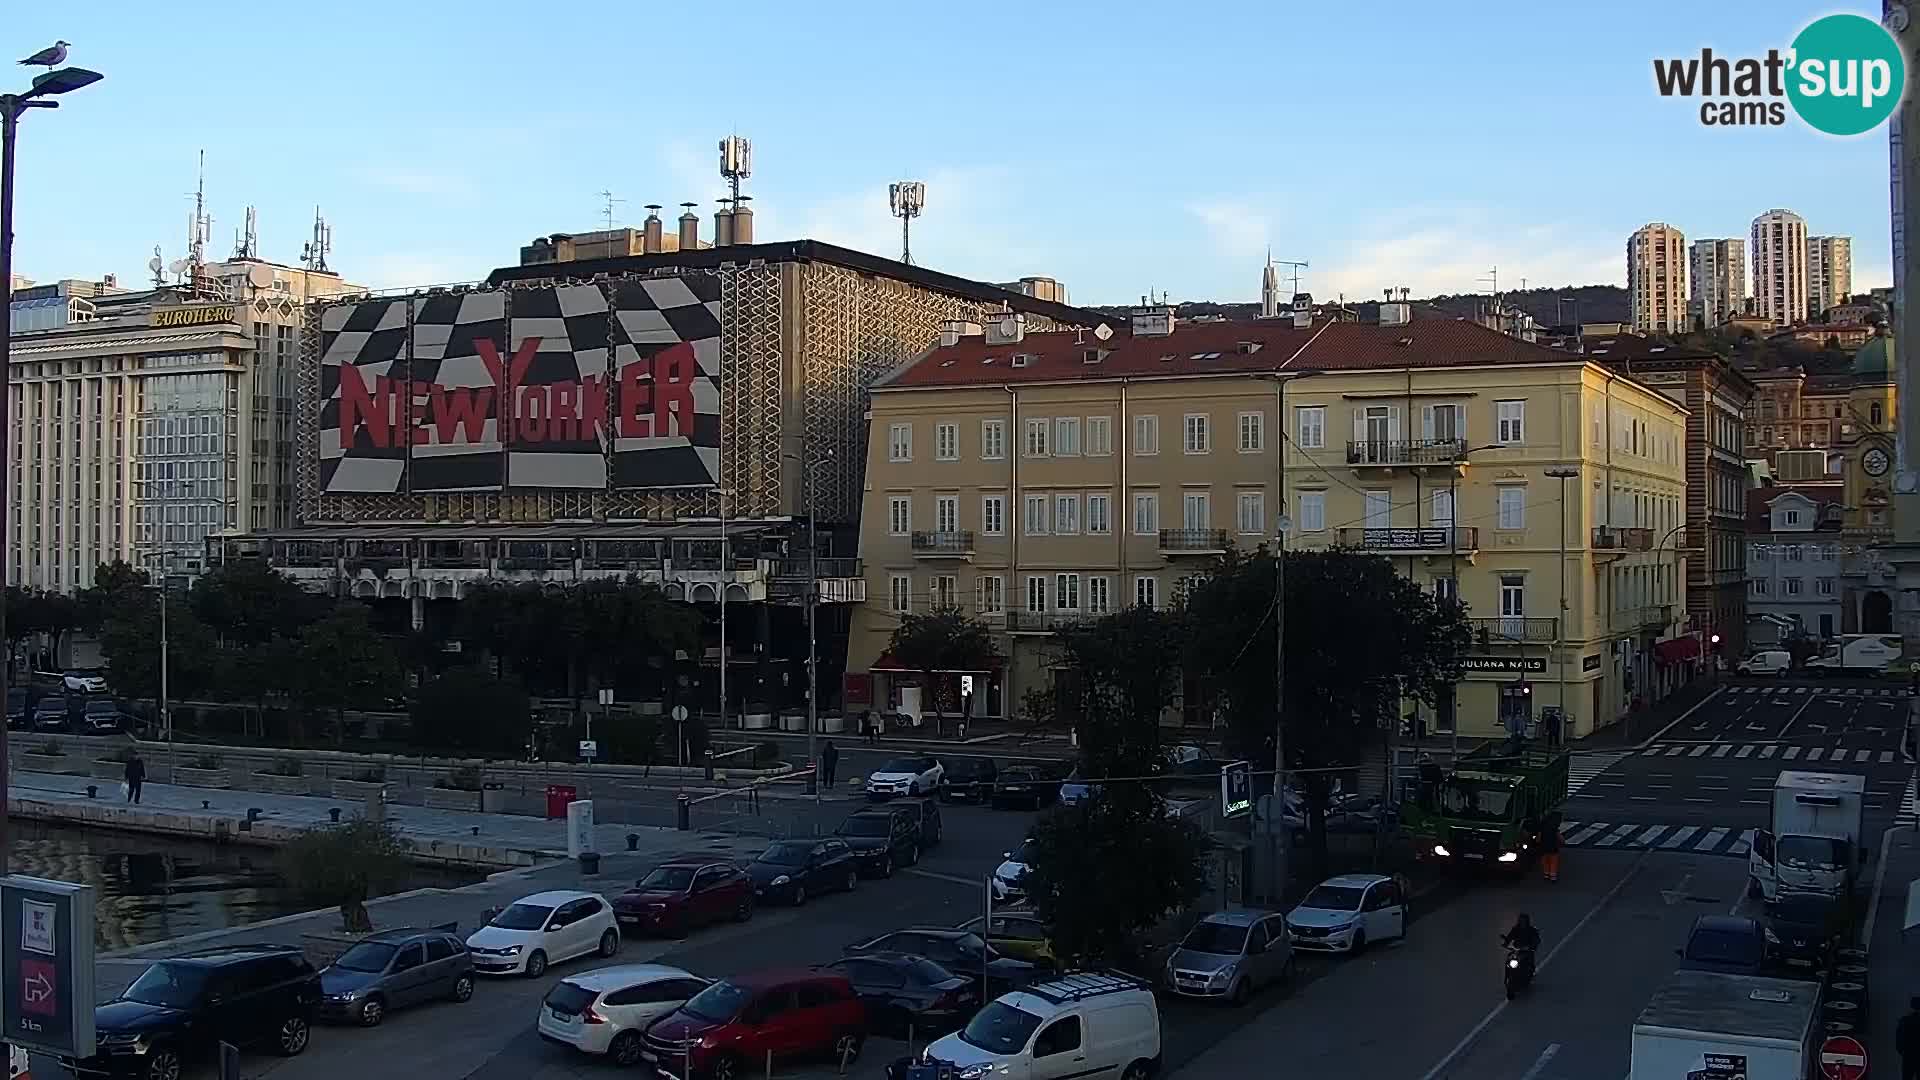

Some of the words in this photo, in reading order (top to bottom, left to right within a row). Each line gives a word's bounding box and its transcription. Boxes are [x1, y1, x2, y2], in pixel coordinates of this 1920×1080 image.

[155, 306, 234, 327] EUROHERC
[1459, 660, 1505, 669] JULIANA
[1509, 661, 1541, 669] NAILS
